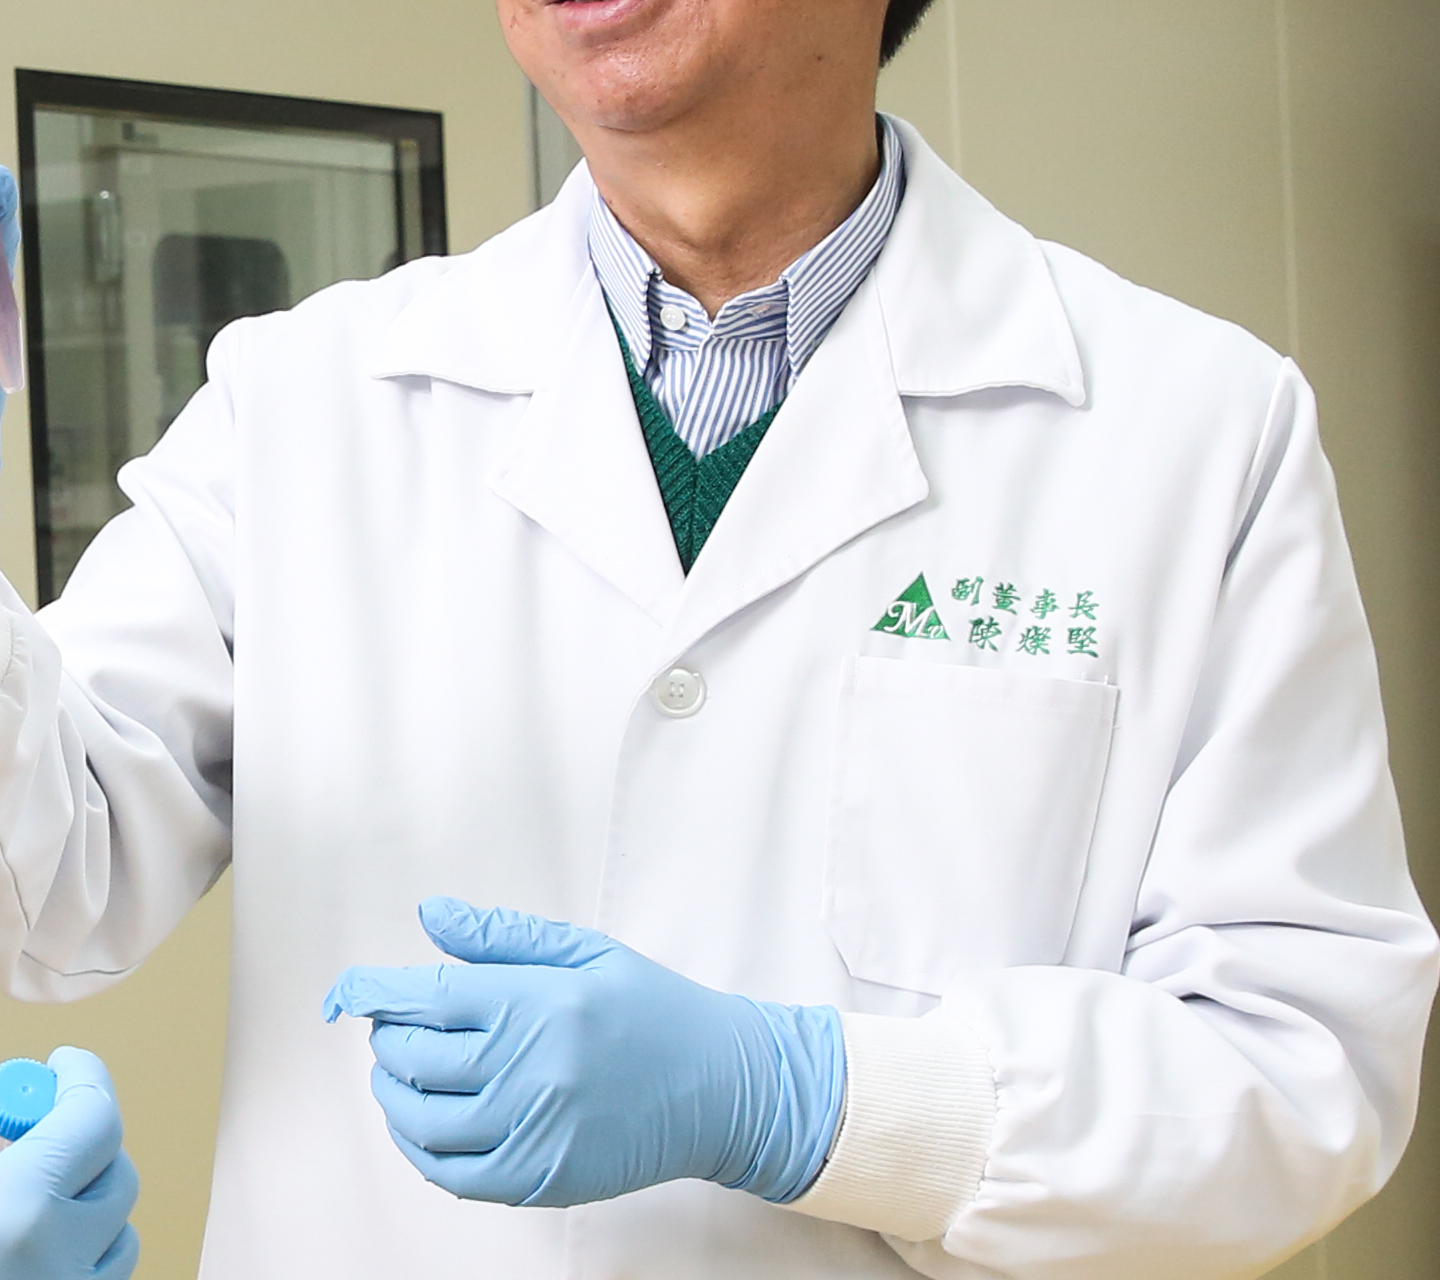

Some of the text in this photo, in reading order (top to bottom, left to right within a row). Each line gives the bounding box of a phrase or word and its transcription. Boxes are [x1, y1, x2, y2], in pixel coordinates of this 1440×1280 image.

[951, 576, 1100, 621] 副董事長
[967, 615, 1100, 658] 陳燦堅
